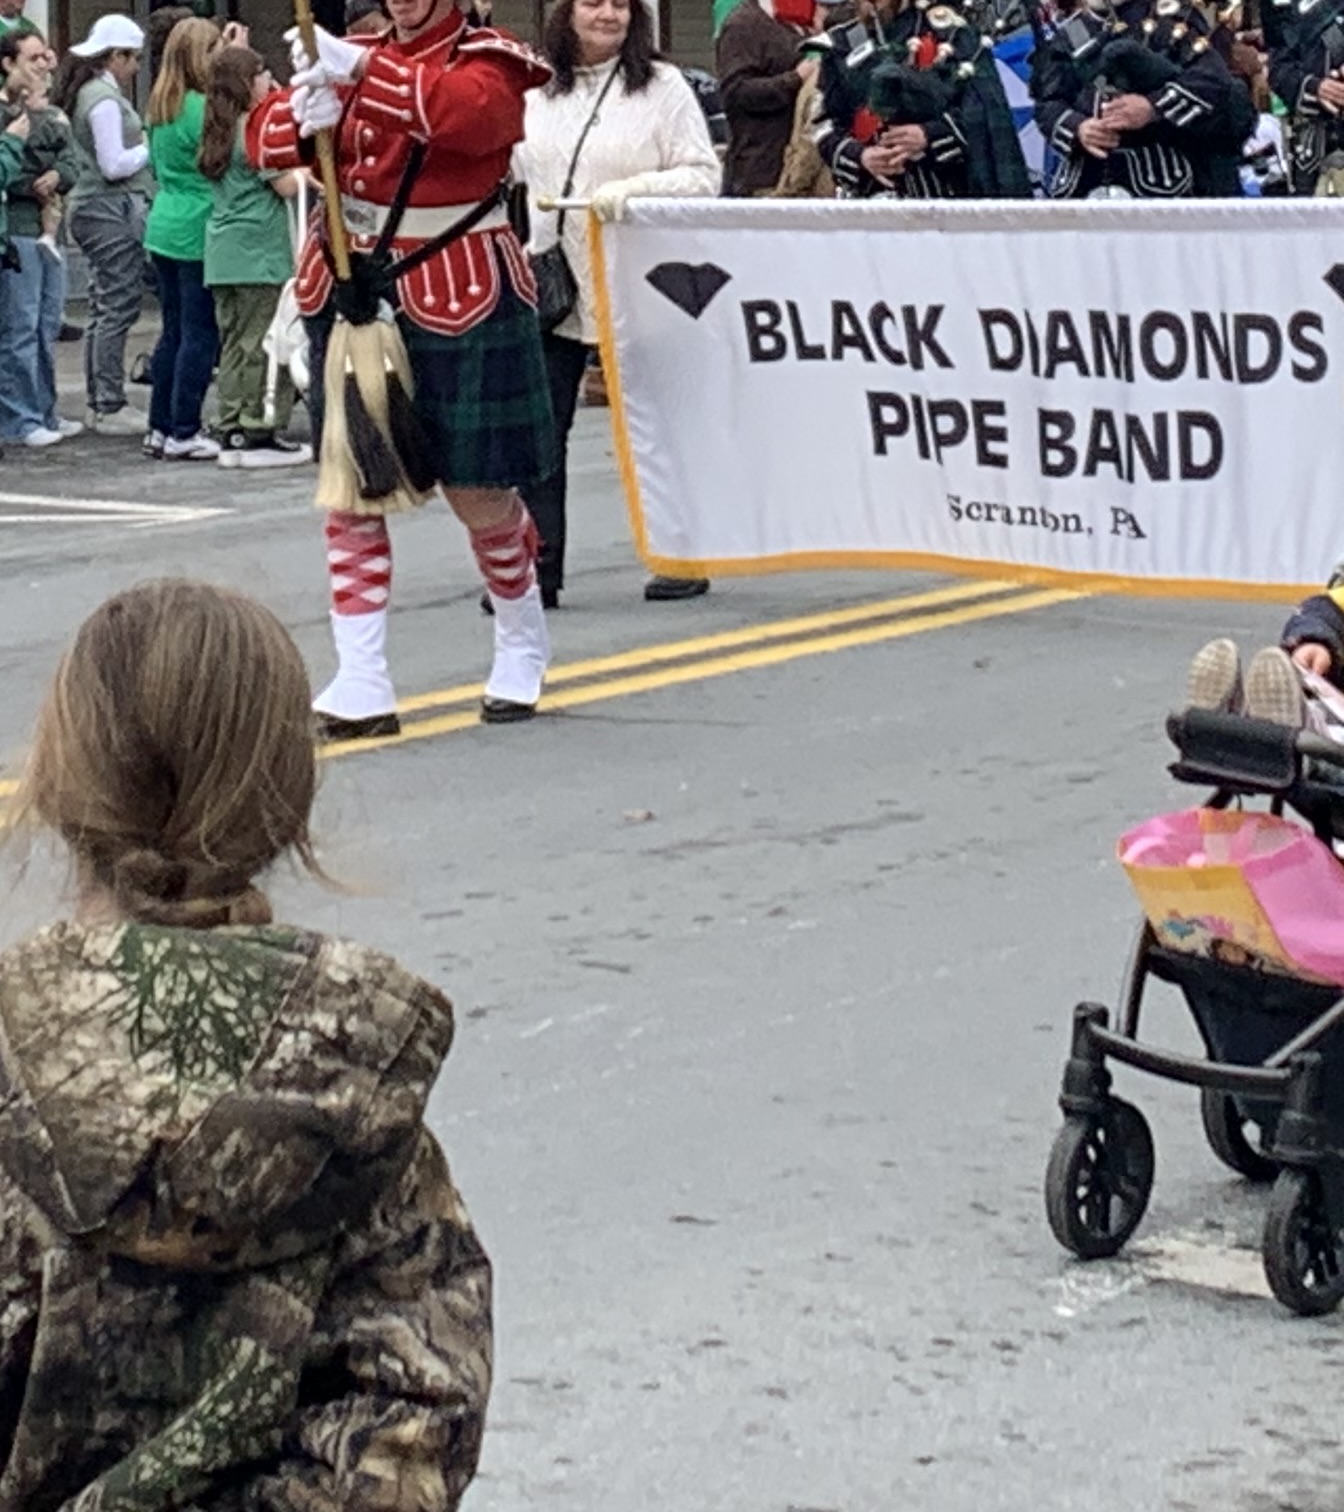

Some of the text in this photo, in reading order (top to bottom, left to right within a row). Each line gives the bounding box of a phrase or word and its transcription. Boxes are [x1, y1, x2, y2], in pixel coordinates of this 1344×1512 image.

[741, 299, 1328, 385] BLACK DIAMONDS
[866, 391, 1224, 484] PIPE BAND
[1110, 506, 1147, 539] PA
